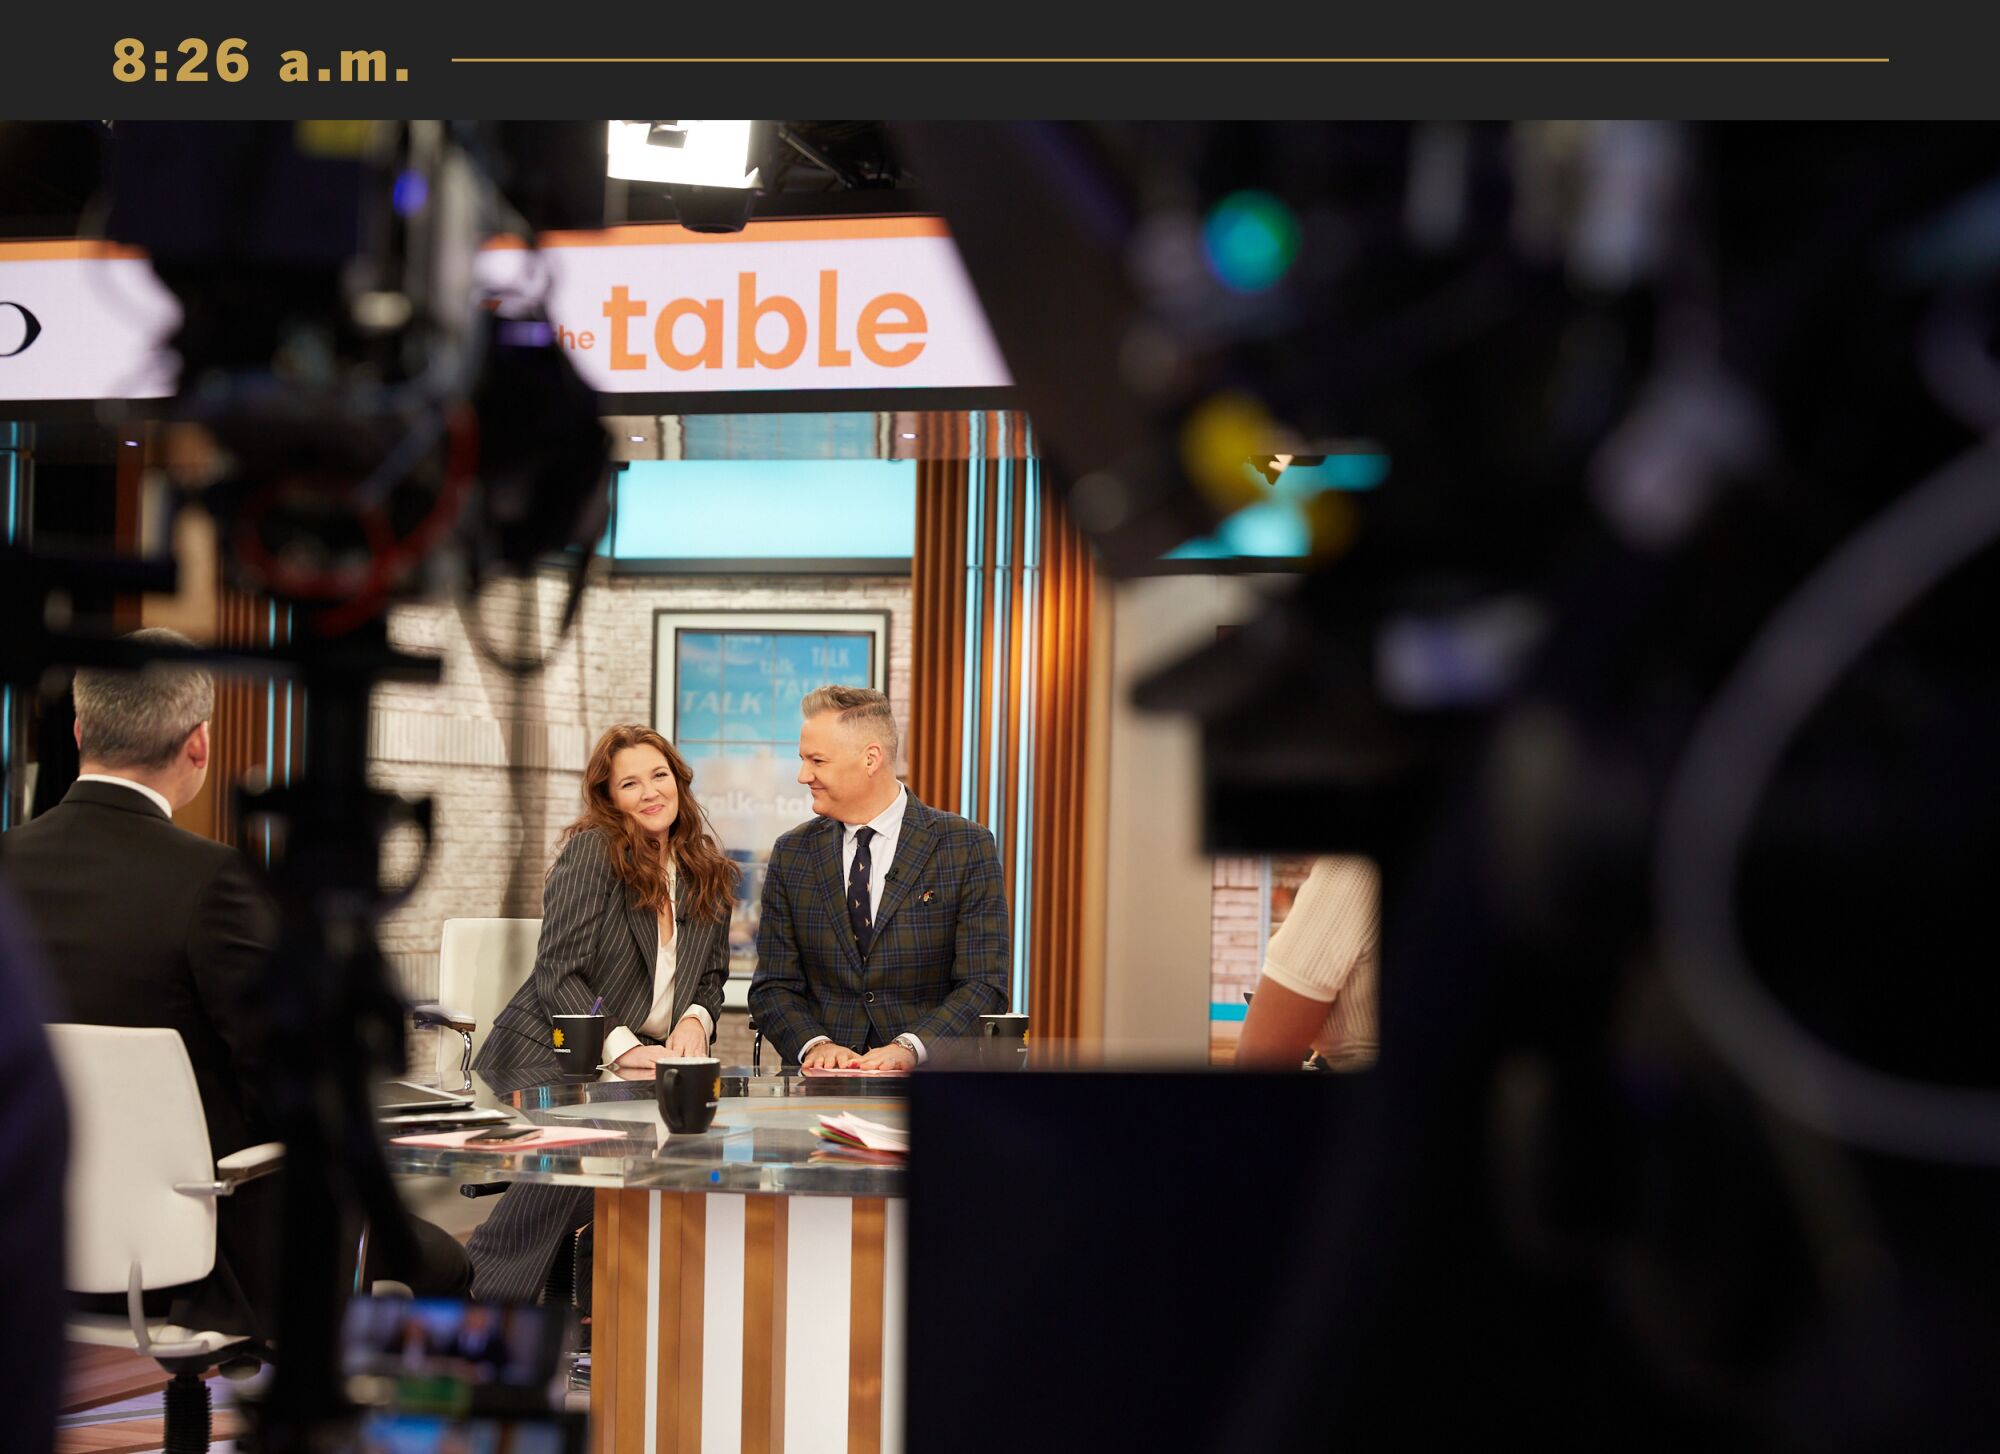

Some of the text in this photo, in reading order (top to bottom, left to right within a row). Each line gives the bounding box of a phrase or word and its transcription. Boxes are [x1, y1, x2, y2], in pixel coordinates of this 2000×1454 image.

[554, 269, 928, 371] he table
[682, 690, 764, 715] TALK
